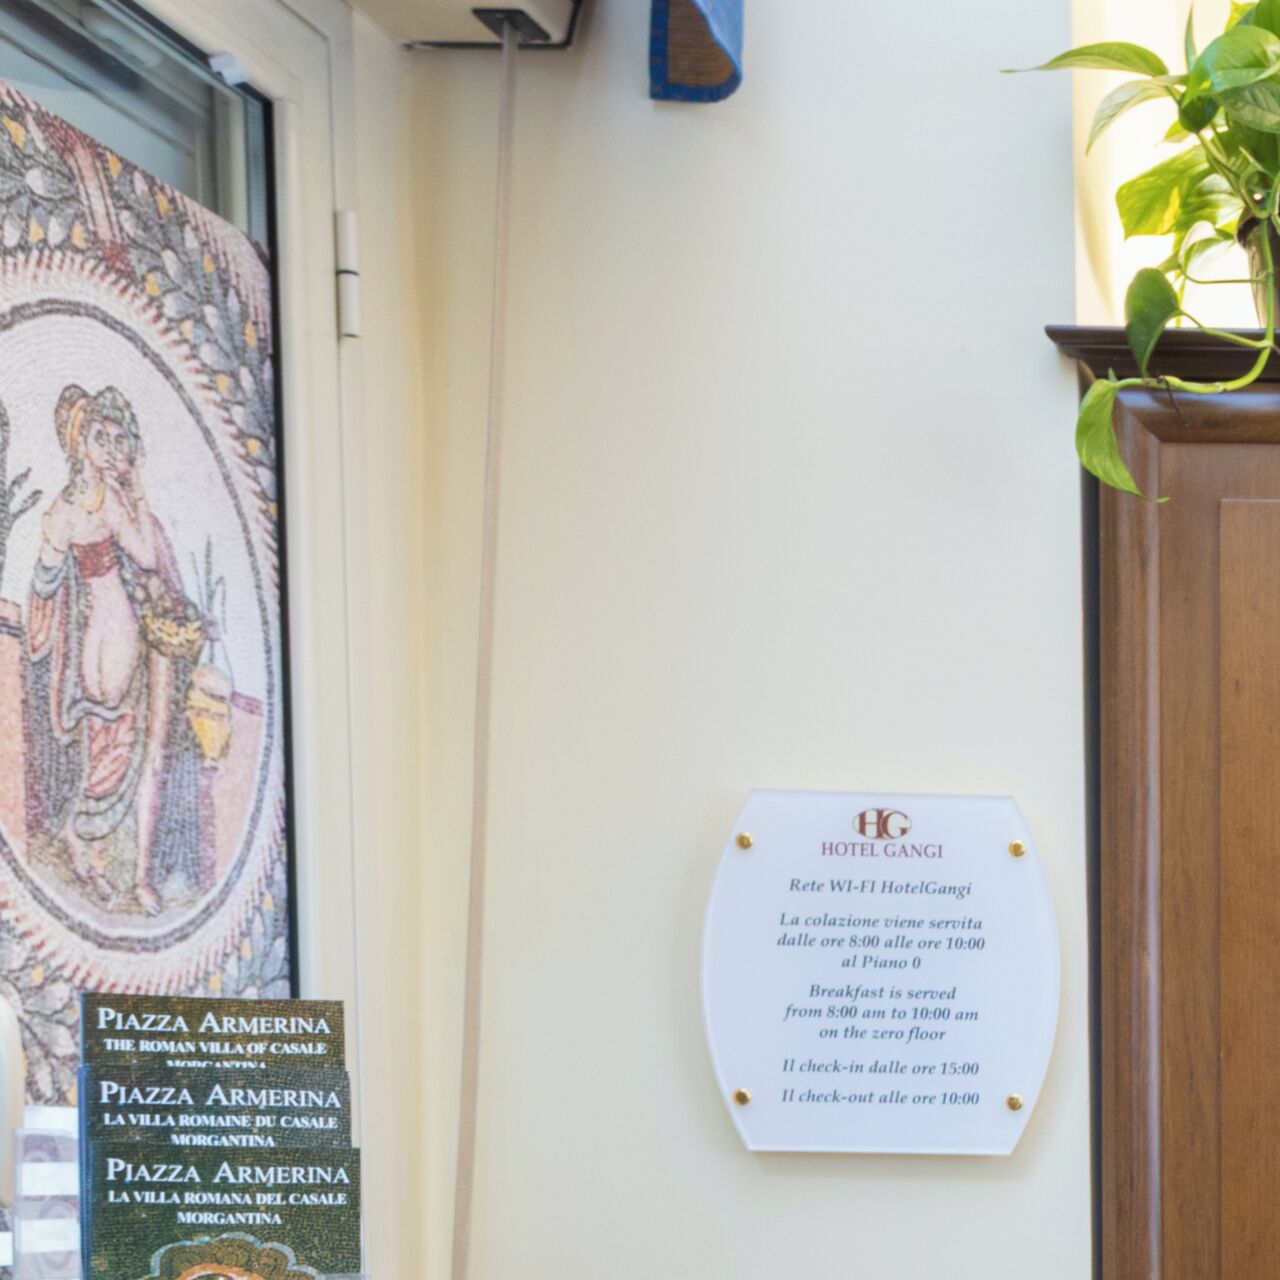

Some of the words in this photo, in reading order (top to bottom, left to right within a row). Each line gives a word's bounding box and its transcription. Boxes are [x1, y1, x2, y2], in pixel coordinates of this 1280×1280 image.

[821, 842, 879, 857] HOTEL
[884, 843, 943, 858] GANGI
[789, 878, 824, 892] Rete
[830, 880, 875, 893] WI-FI
[881, 880, 972, 899] HotelGangi
[779, 913, 799, 926] La
[804, 913, 879, 928] colazione
[884, 915, 925, 929] viene
[929, 916, 982, 930] servita
[777, 933, 815, 947] dalle
[820, 937, 844, 947] ore
[849, 934, 880, 948] 8:00
[884, 935, 913, 949] alle
[918, 939, 942, 949] ore
[947, 937, 985, 950] 10:00
[841, 955, 857, 968] al
[862, 955, 908, 969] Piano
[912, 956, 921, 969] 0
[809, 984, 884, 1002] Breakfast
[889, 986, 902, 999] is
[907, 986, 957, 1000] served
[97, 1007, 189, 1032] PIAZZA
[199, 1011, 331, 1035] ARMERINA
[783, 1003, 822, 1022] from
[826, 1005, 857, 1018] 8:00
[862, 1009, 886, 1019] am
[891, 1007, 907, 1020] to
[912, 1007, 950, 1021] 10:00
[955, 1010, 979, 1021] am
[819, 1028, 838, 1039] on
[843, 1026, 867, 1039] the
[872, 1029, 904, 1040] zero
[906, 1026, 946, 1044] floor
[103, 1038, 135, 1051] THE
[139, 1040, 195, 1053] ROMAN
[200, 1041, 246, 1054] VILLA
[248, 1042, 268, 1054] OF
[270, 1042, 327, 1055] CASALE
[782, 1059, 795, 1073] Il
[799, 1059, 864, 1073] check-in
[869, 1060, 908, 1074] dalle
[912, 1064, 936, 1075] ore
[940, 1062, 979, 1075] 15:00
[100, 1081, 194, 1104] PIAZZA
[205, 1084, 341, 1109] ARMERINA
[782, 1089, 794, 1103] Il
[799, 1089, 874, 1104] check-out
[878, 1091, 908, 1104] alle
[912, 1095, 936, 1105] ore
[940, 1092, 980, 1105] 10:00
[103, 1113, 126, 1126] LA
[127, 1114, 175, 1127] VILLA
[179, 1115, 251, 1127] ROMAINE
[255, 1116, 276, 1128] DU
[280, 1116, 337, 1129] CASALE
[170, 1134, 275, 1147] MORGANTINA
[106, 1158, 201, 1182] PIAZZA
[213, 1161, 349, 1186] ARMERINA
[108, 1190, 130, 1203] LA
[133, 1191, 180, 1203] VILLA
[184, 1192, 252, 1205] ROMANA
[256, 1192, 286, 1205] DEL
[288, 1193, 347, 1206] CASALE
[177, 1211, 282, 1225] MORGANTINA
